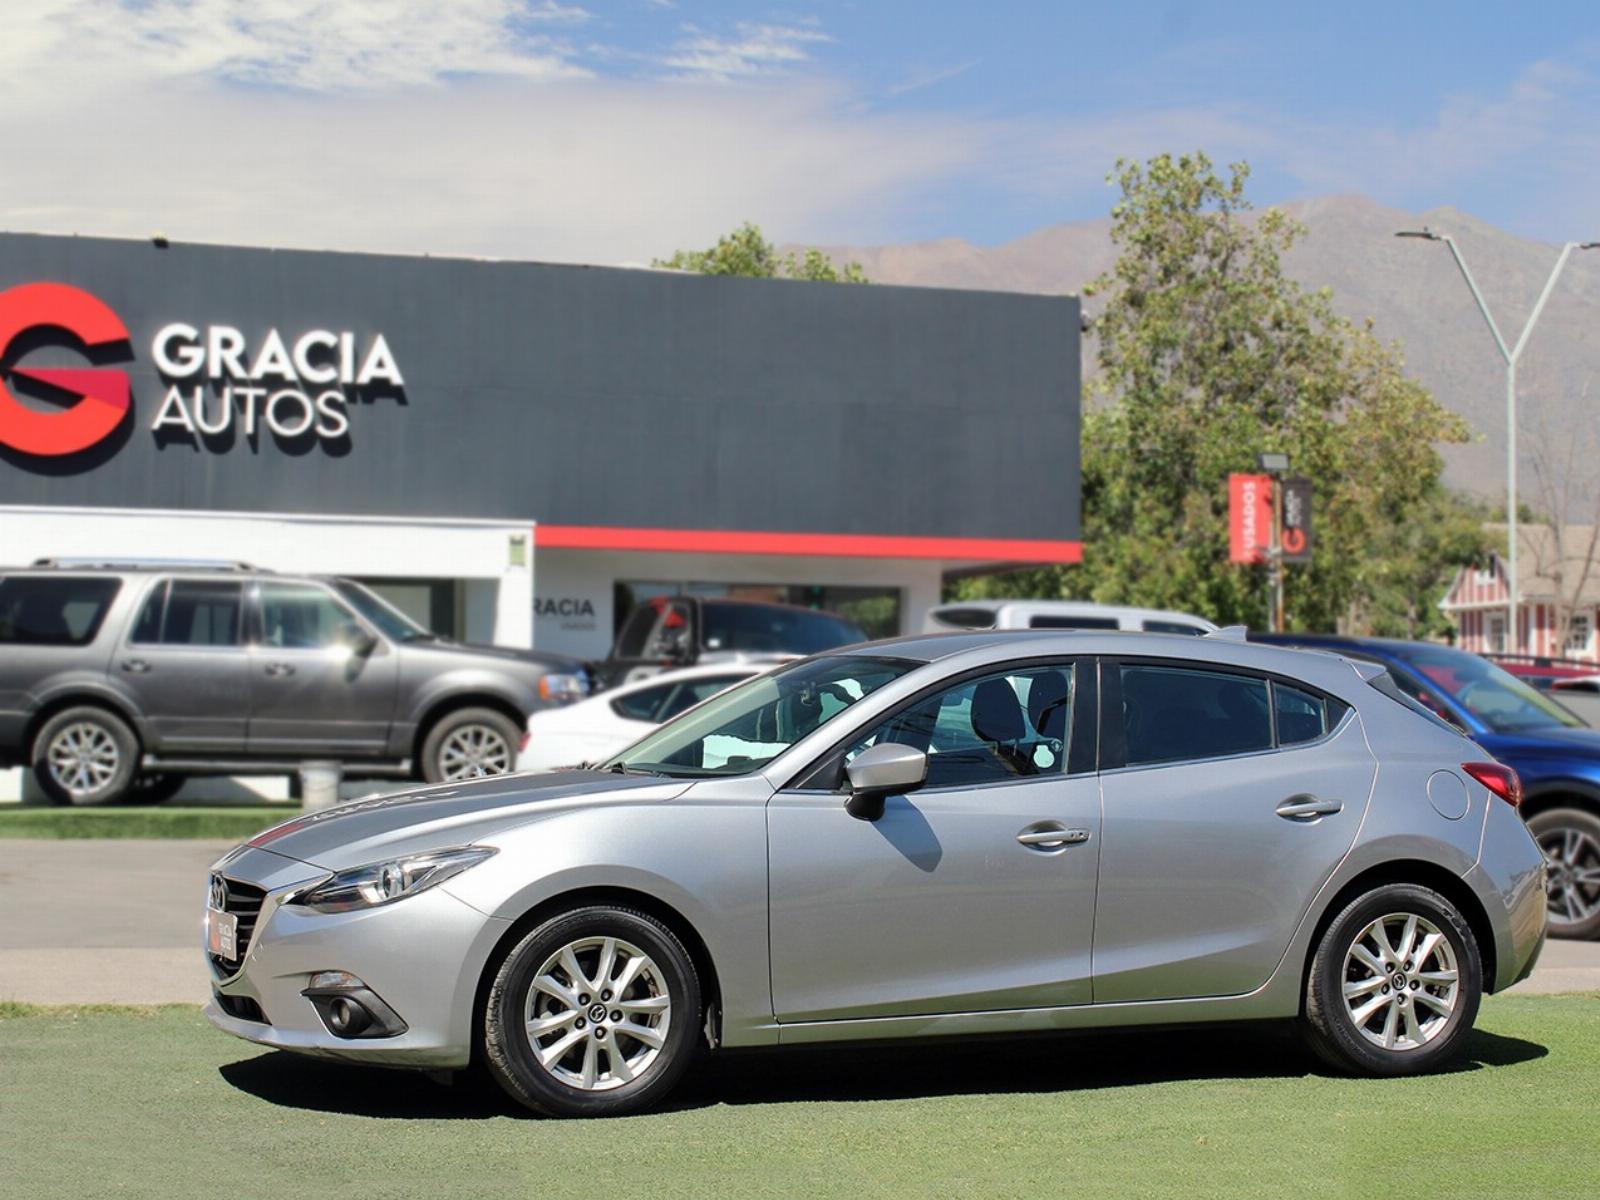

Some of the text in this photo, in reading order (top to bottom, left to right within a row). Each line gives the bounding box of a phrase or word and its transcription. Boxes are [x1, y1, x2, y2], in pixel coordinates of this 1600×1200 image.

[152, 322, 405, 386] GRACIA
[151, 383, 349, 437] AUTOS
[1242, 481, 1256, 549] USADOS
